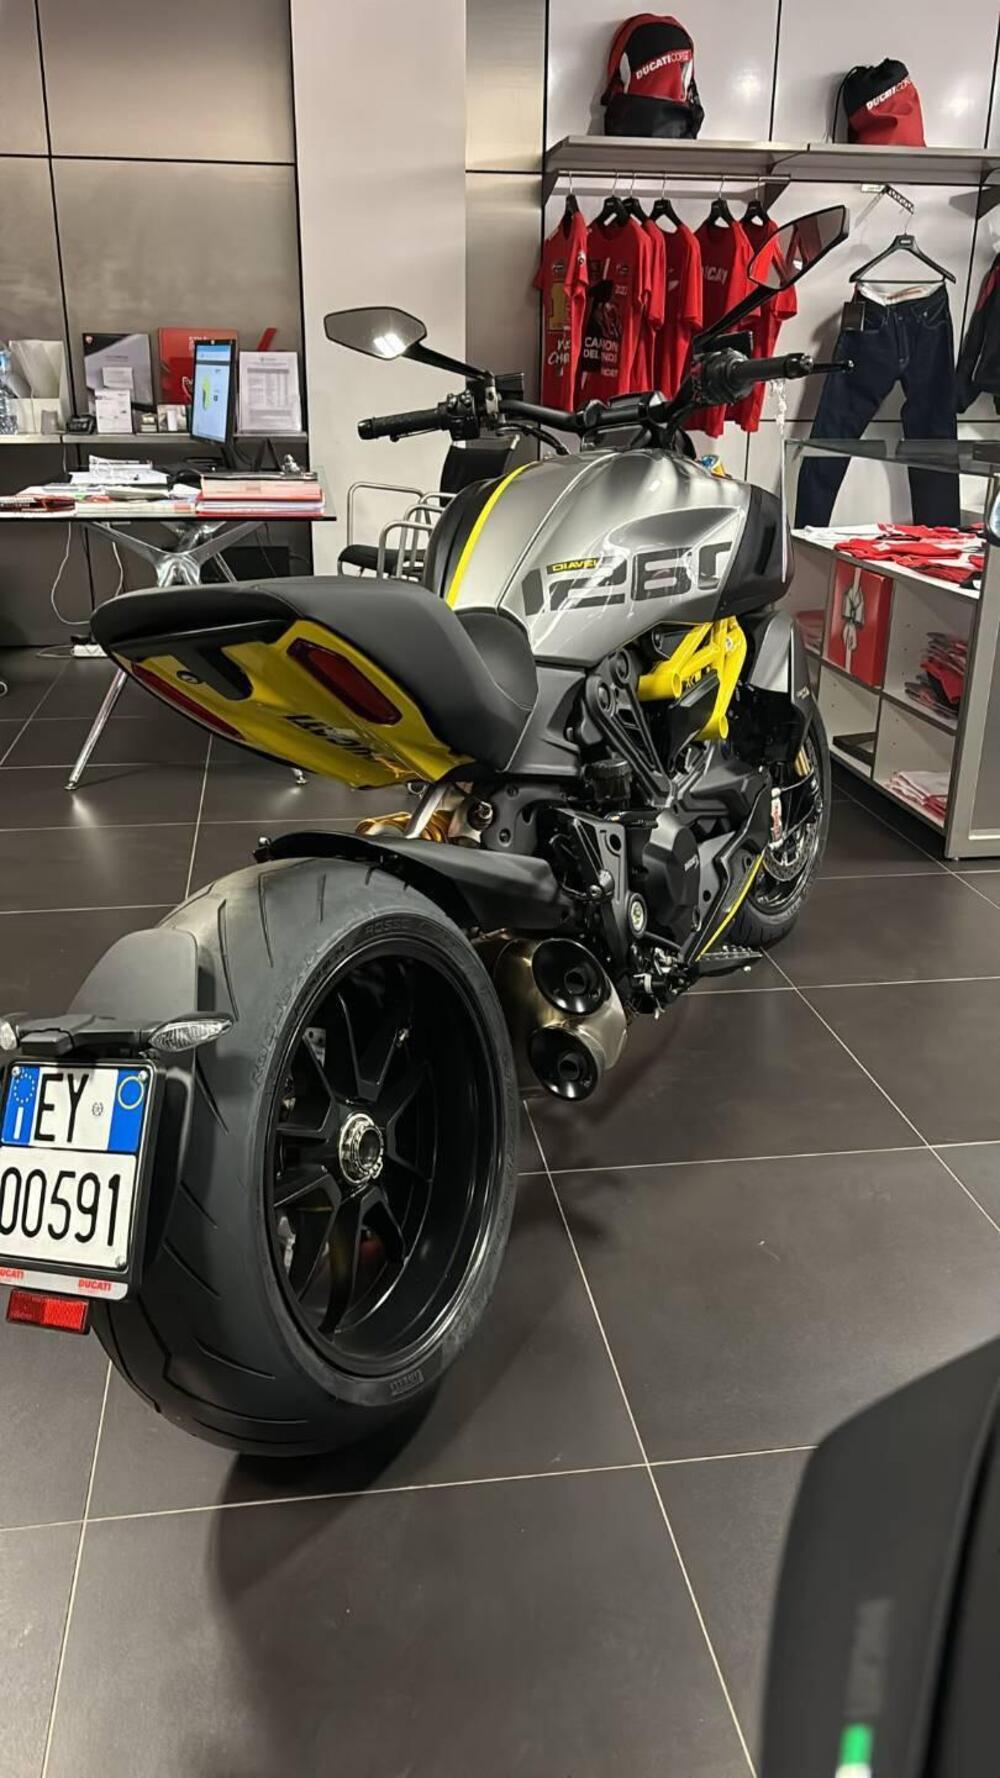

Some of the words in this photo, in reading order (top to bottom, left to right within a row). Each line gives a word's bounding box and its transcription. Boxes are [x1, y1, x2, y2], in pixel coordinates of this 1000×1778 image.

[34, 1073, 89, 1143] EY
[0, 1167, 121, 1247] 00591
[0, 1268, 24, 1280] UCATI
[78, 1279, 112, 1291] DUCATI
